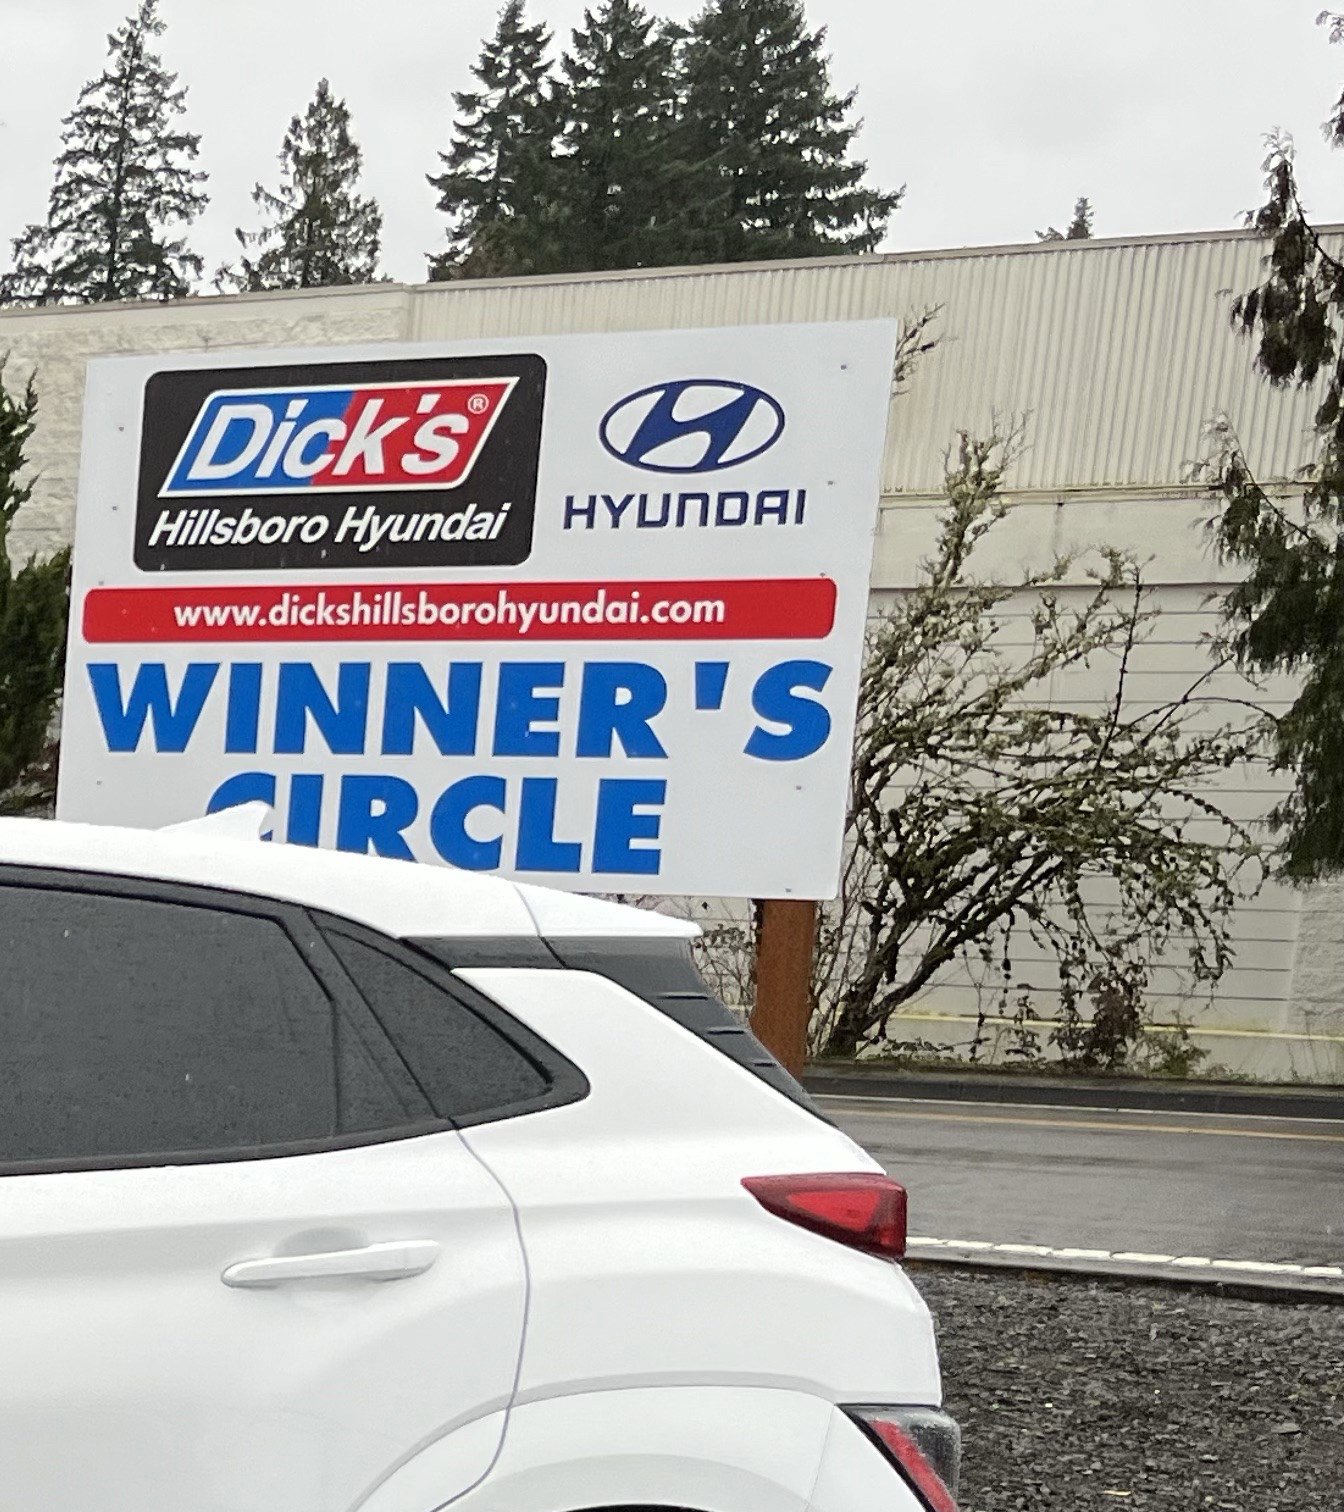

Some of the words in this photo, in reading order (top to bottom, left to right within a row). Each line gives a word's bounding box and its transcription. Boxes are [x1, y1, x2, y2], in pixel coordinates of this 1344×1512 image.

[148, 508, 330, 547] Hillsboro
[333, 502, 512, 553] Hyundai
[563, 489, 807, 530] HYUNDAI
[173, 589, 725, 634] www.dickshillsborohyundai.com
[87, 660, 832, 761] WINNER'S
